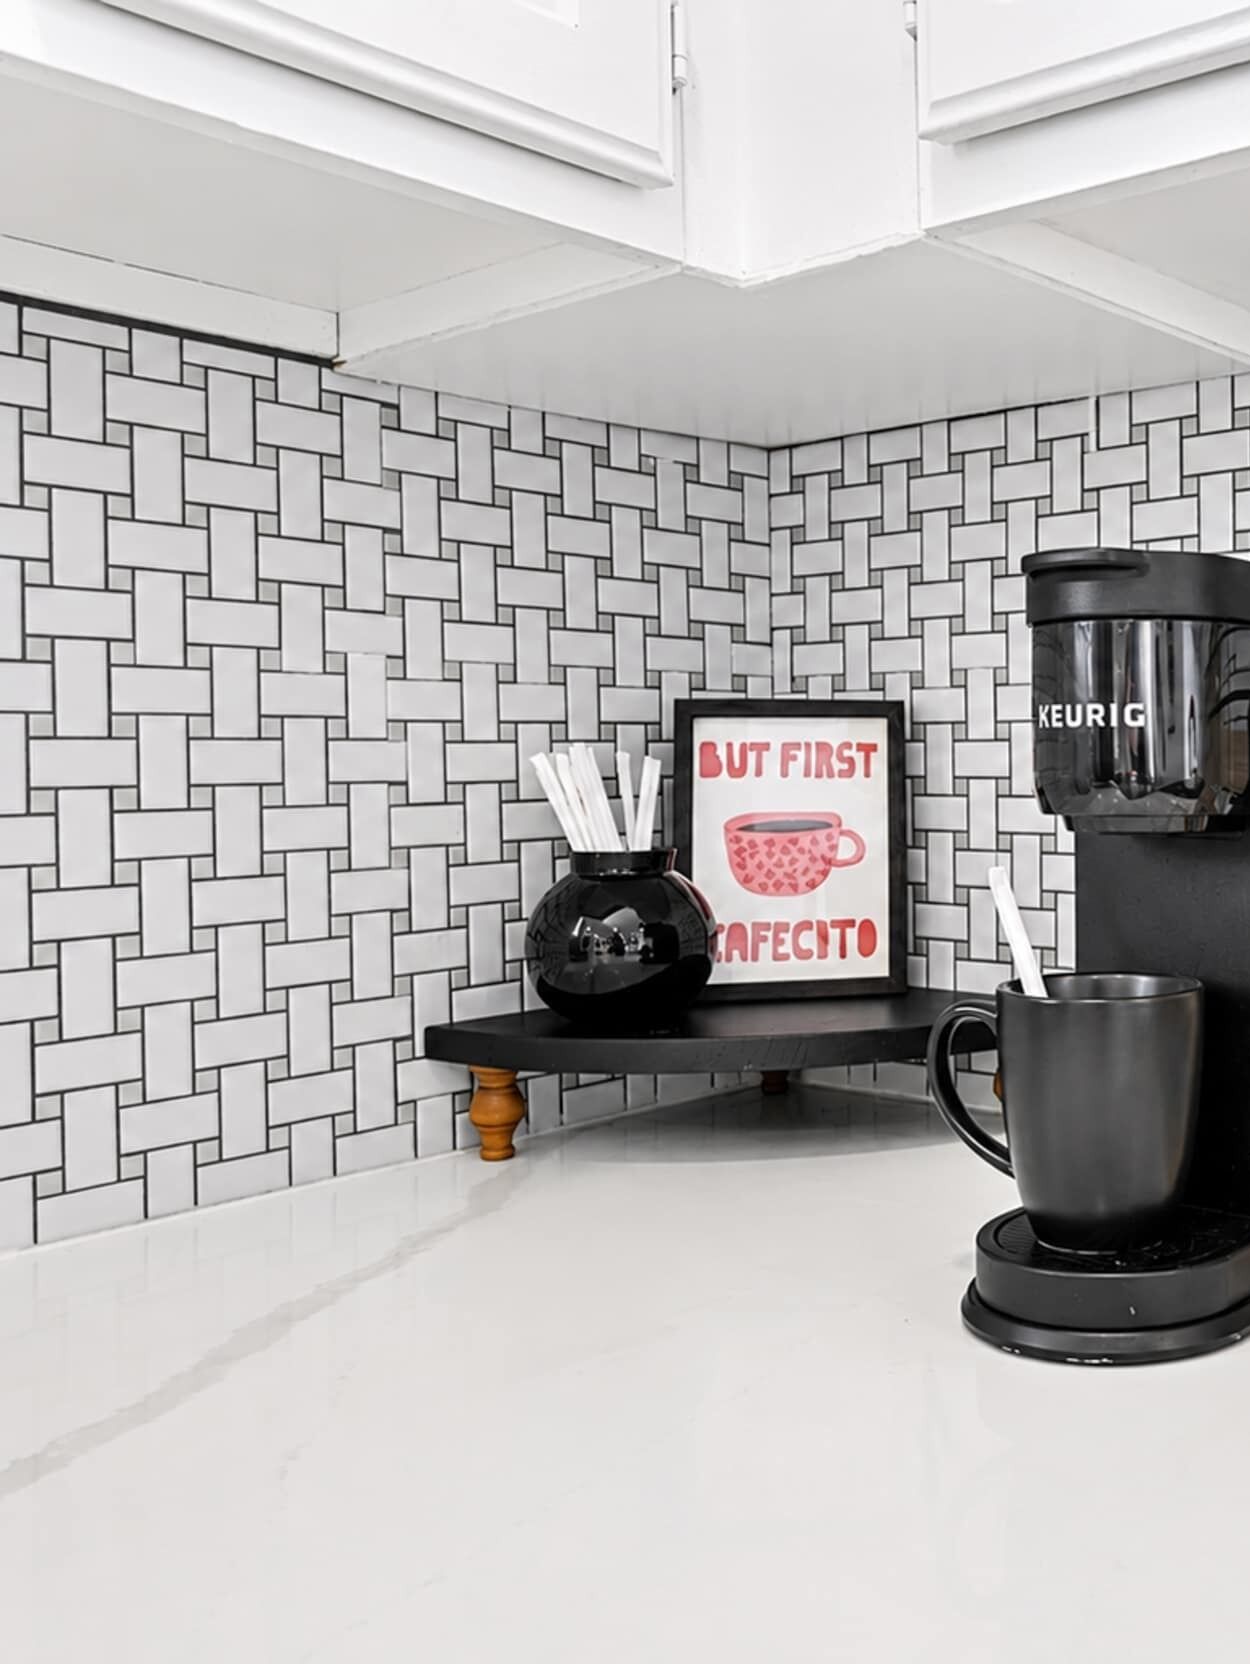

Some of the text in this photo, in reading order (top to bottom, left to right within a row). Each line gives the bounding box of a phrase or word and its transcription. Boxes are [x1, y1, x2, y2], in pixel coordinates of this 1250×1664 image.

[1038, 702, 1146, 729] KEURIG
[699, 740, 878, 779] BUT FIRST
